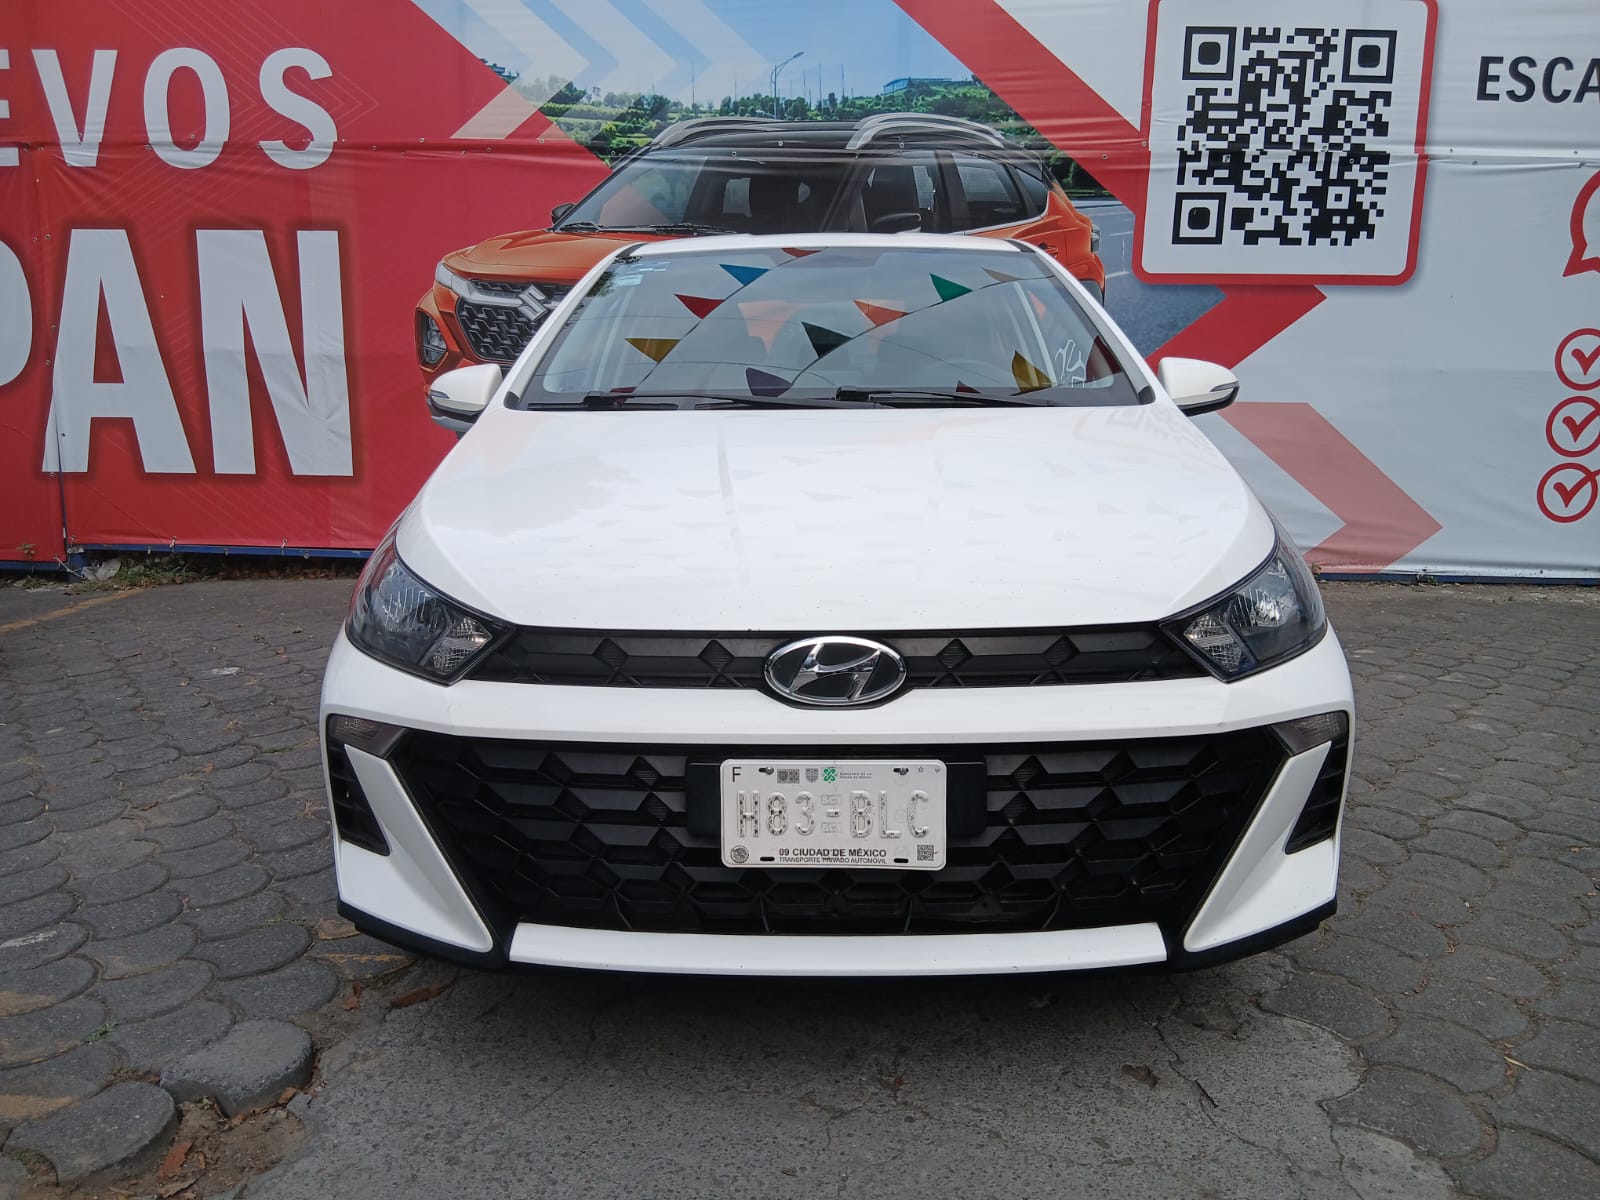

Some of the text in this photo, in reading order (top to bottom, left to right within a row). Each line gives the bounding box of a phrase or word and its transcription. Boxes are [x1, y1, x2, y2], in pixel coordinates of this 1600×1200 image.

[0, 228, 354, 477] AN
[732, 766, 742, 783] F
[737, 789, 929, 839] H83-BLC
[778, 847, 887, 858] 09 CIUDAD DE MÉXICO
